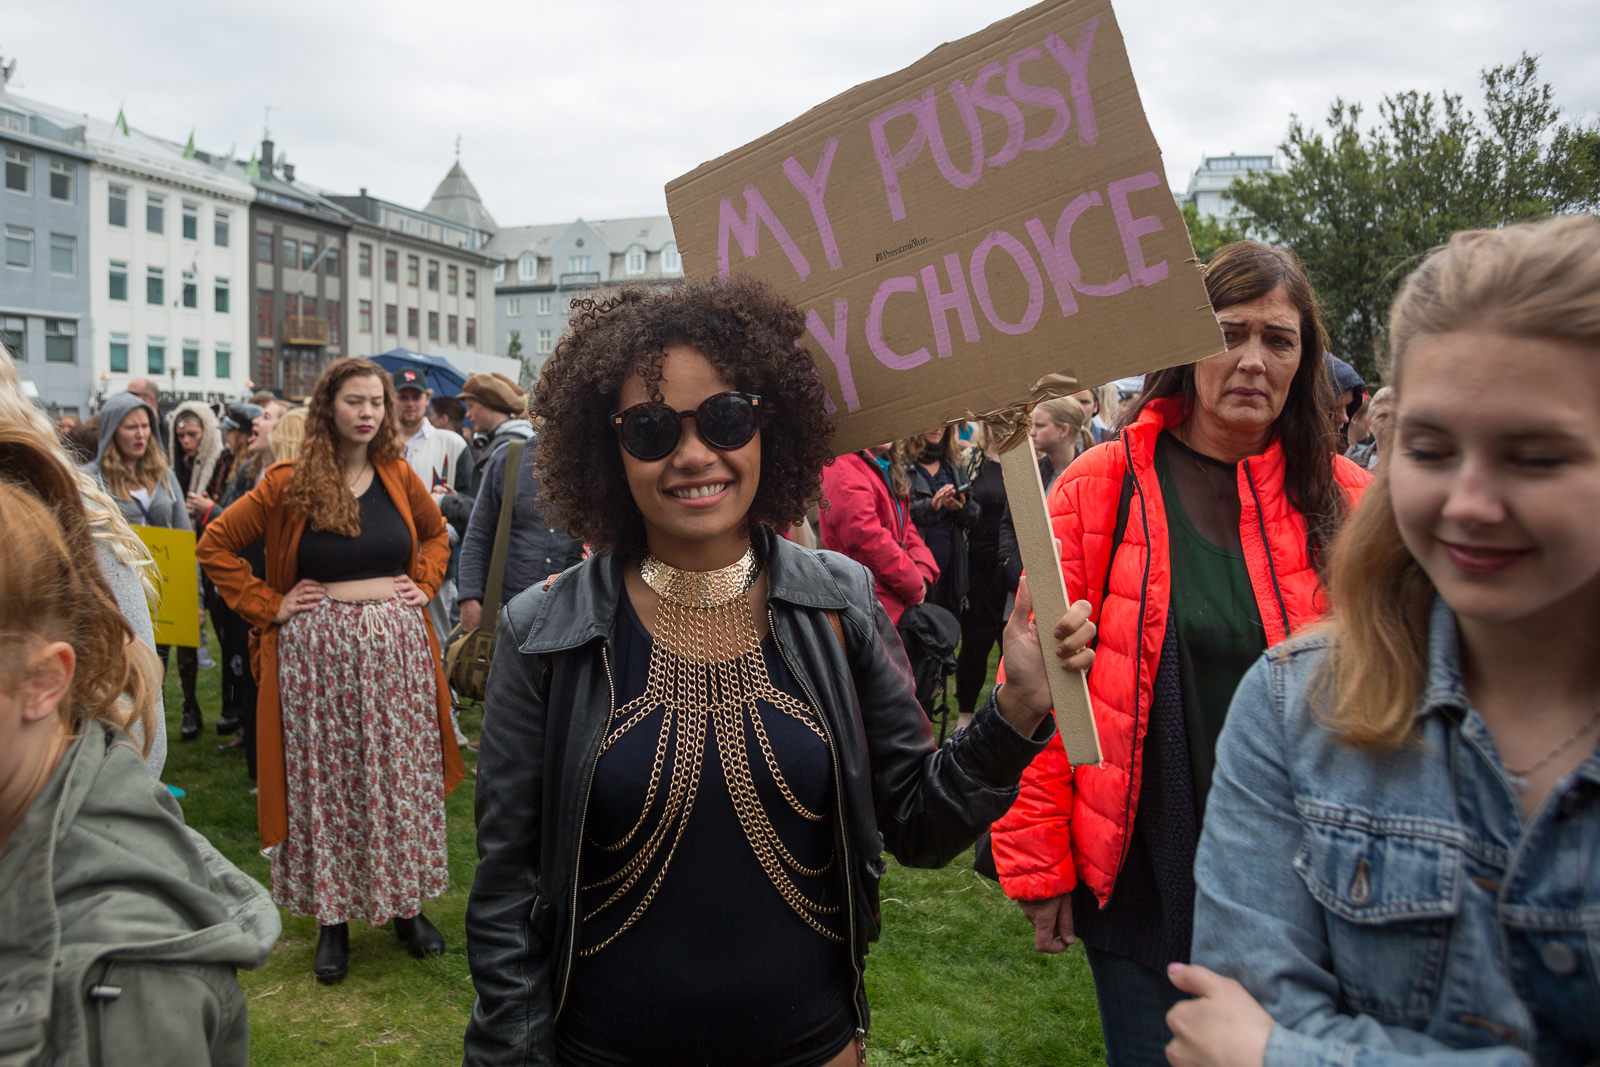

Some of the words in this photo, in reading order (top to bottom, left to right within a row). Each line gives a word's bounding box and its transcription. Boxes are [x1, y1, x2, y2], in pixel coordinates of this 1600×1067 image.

[717, 137, 842, 285] MY
[868, 18, 1099, 222] PUSSY
[793, 297, 860, 414] Y
[866, 171, 1169, 371] CHOICE
